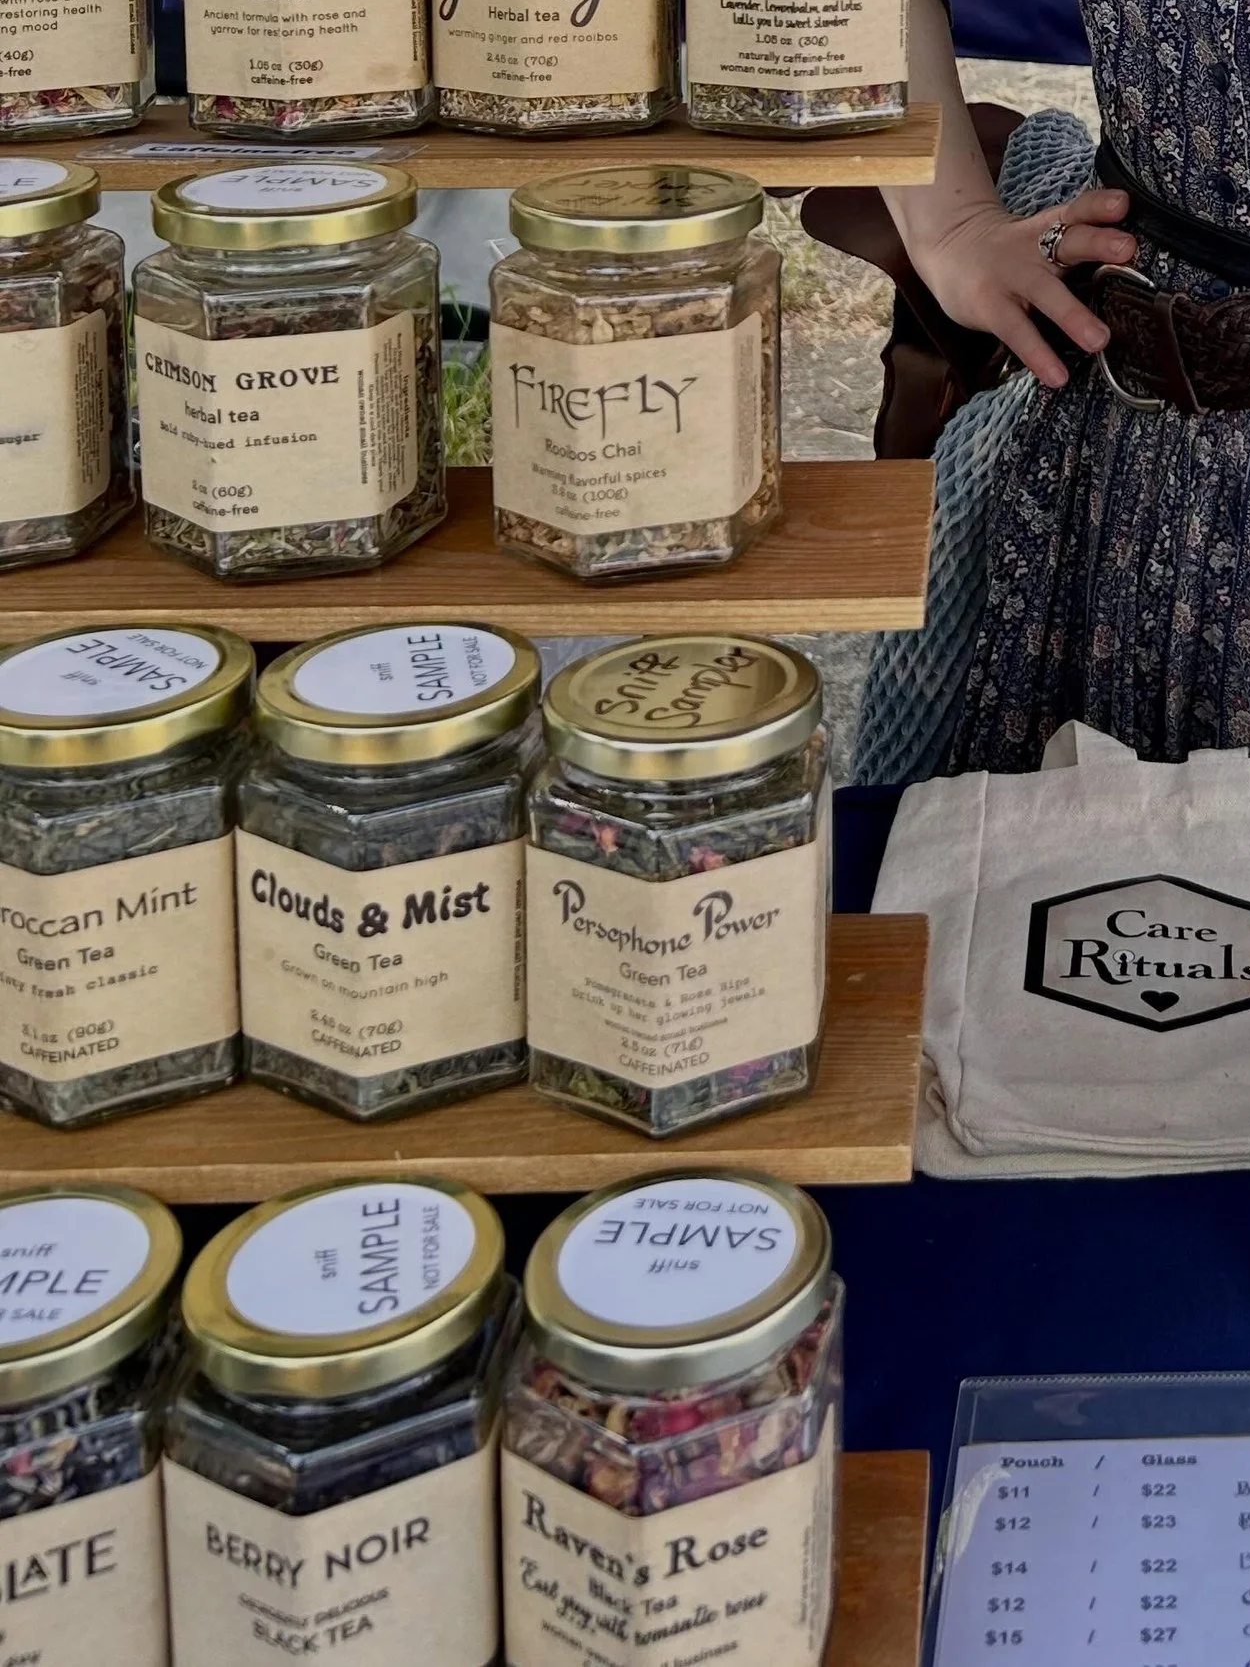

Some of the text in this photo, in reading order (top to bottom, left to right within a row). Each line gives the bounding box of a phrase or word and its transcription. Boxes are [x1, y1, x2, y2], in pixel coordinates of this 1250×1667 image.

[63, 5, 102, 16] health
[203, 8, 366, 23] Ancient with rose and
[489, 6, 560, 22] Herbal tea
[22, 21, 58, 32] mood
[319, 23, 358, 34] health
[521, 34, 567, 44] and red
[739, 51, 780, 64] naturally
[720, 63, 819, 77] woman owned small
[145, 352, 340, 393] CRIMSON GROVE
[510, 362, 699, 438] FIREFLY
[184, 401, 260, 424] herbal tea
[245, 433, 317, 448] infusion
[602, 441, 642, 460] Chai
[626, 467, 668, 483] spices
[66, 638, 187, 691] SAMPLE
[407, 633, 454, 703] SAMPLE
[0, 882, 197, 937] roccan Mint
[252, 868, 490, 937] Clouds & Mist
[553, 879, 692, 957] Persephone
[693, 890, 781, 942] Power
[1106, 909, 1218, 942] Care
[17, 946, 115, 971] Green Tea
[313, 943, 404, 974] Green Tea
[415, 970, 449, 989] high
[619, 962, 708, 987] Green Tea
[20, 1038, 120, 1063] CAFFEINATED
[619, 1052, 710, 1076] CAFFEINATED
[634, 1198, 769, 1216] NOT FOR SALE
[594, 1219, 783, 1252] SAMPLE
[358, 1198, 400, 1316] SAMPLE
[647, 1259, 701, 1275] sniff
[12, 1308, 62, 1321] SALE
[1001, 1456, 1064, 1469] Pouch
[1141, 1454, 1197, 1467] Glass
[998, 1486, 1029, 1499] $11
[1141, 1483, 1176, 1497] $22
[995, 1517, 1030, 1531] $12
[1141, 1514, 1176, 1528] $23
[521, 1489, 651, 1588] Raven's
[663, 1526, 769, 1580] Rose
[205, 1517, 430, 1589] BERRY NOIR
[991, 1562, 1027, 1576] $14
[1140, 1559, 1177, 1573] $22
[987, 1598, 1025, 1613] $12
[1140, 1595, 1177, 1611] $22
[327, 1614, 373, 1648] TEA
[1140, 1627, 1177, 1644] $27
